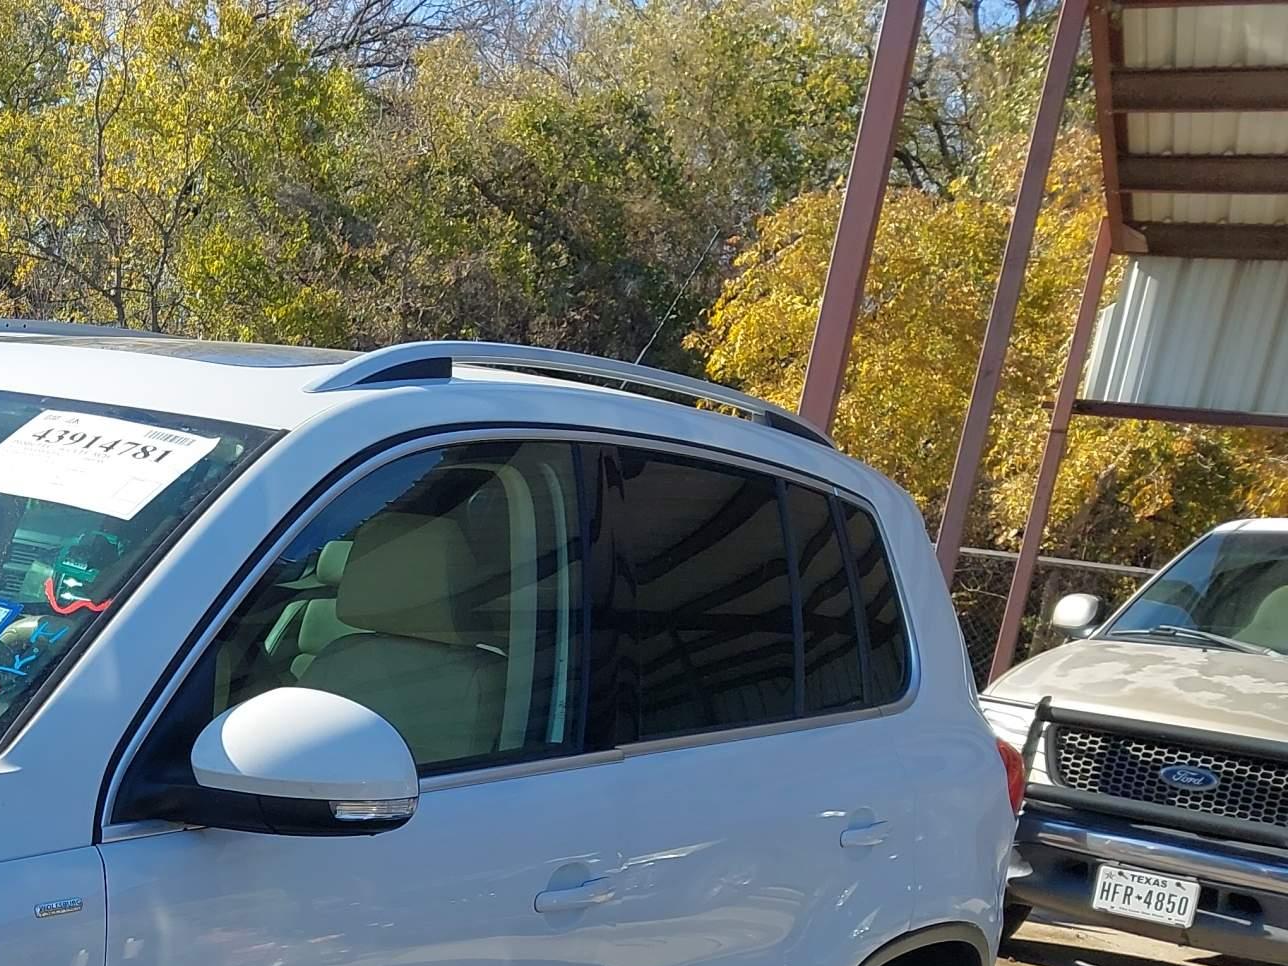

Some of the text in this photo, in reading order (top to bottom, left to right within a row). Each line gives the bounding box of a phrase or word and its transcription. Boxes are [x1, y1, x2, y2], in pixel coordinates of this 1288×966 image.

[32, 427, 173, 463] 43914781
[1172, 770, 1205, 785] Ford
[1130, 873, 1168, 888] TEXAS
